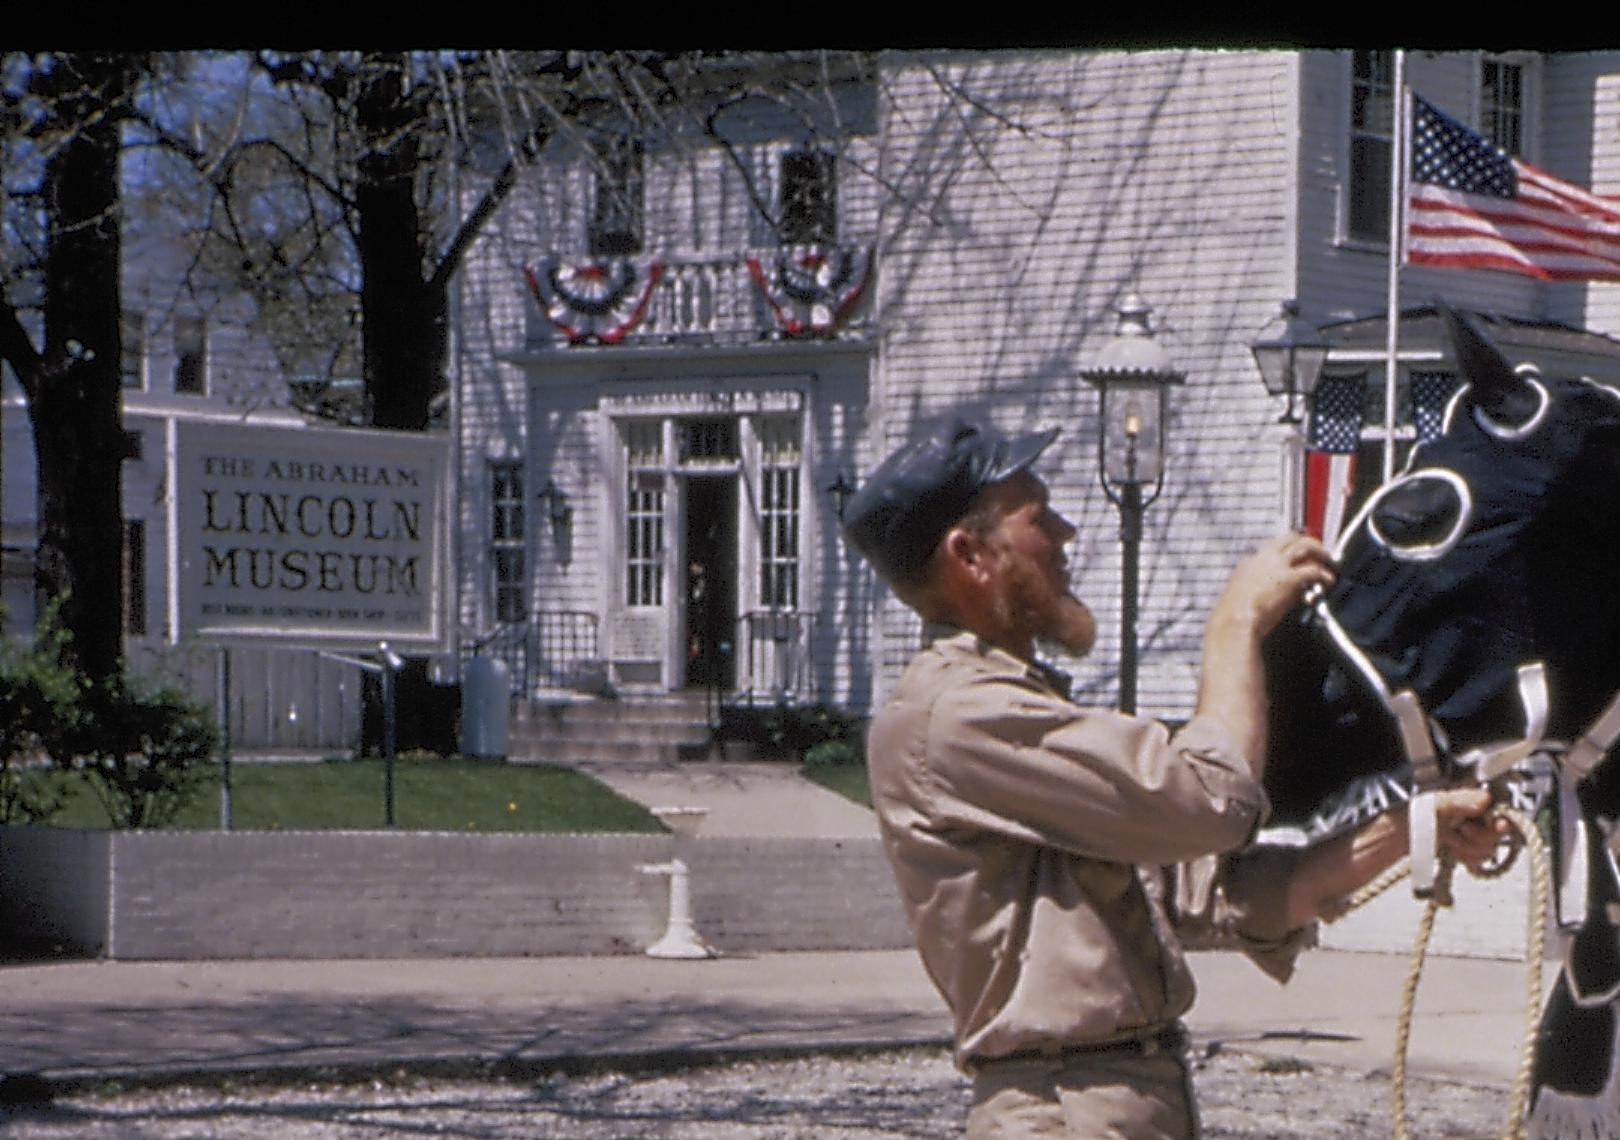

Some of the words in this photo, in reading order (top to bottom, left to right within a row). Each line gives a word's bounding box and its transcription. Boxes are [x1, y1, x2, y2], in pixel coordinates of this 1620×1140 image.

[201, 456, 255, 478] THE
[265, 460, 419, 488] ABRAHAM
[201, 488, 421, 542] LINCOLN
[202, 545, 421, 597] MUSEUM
